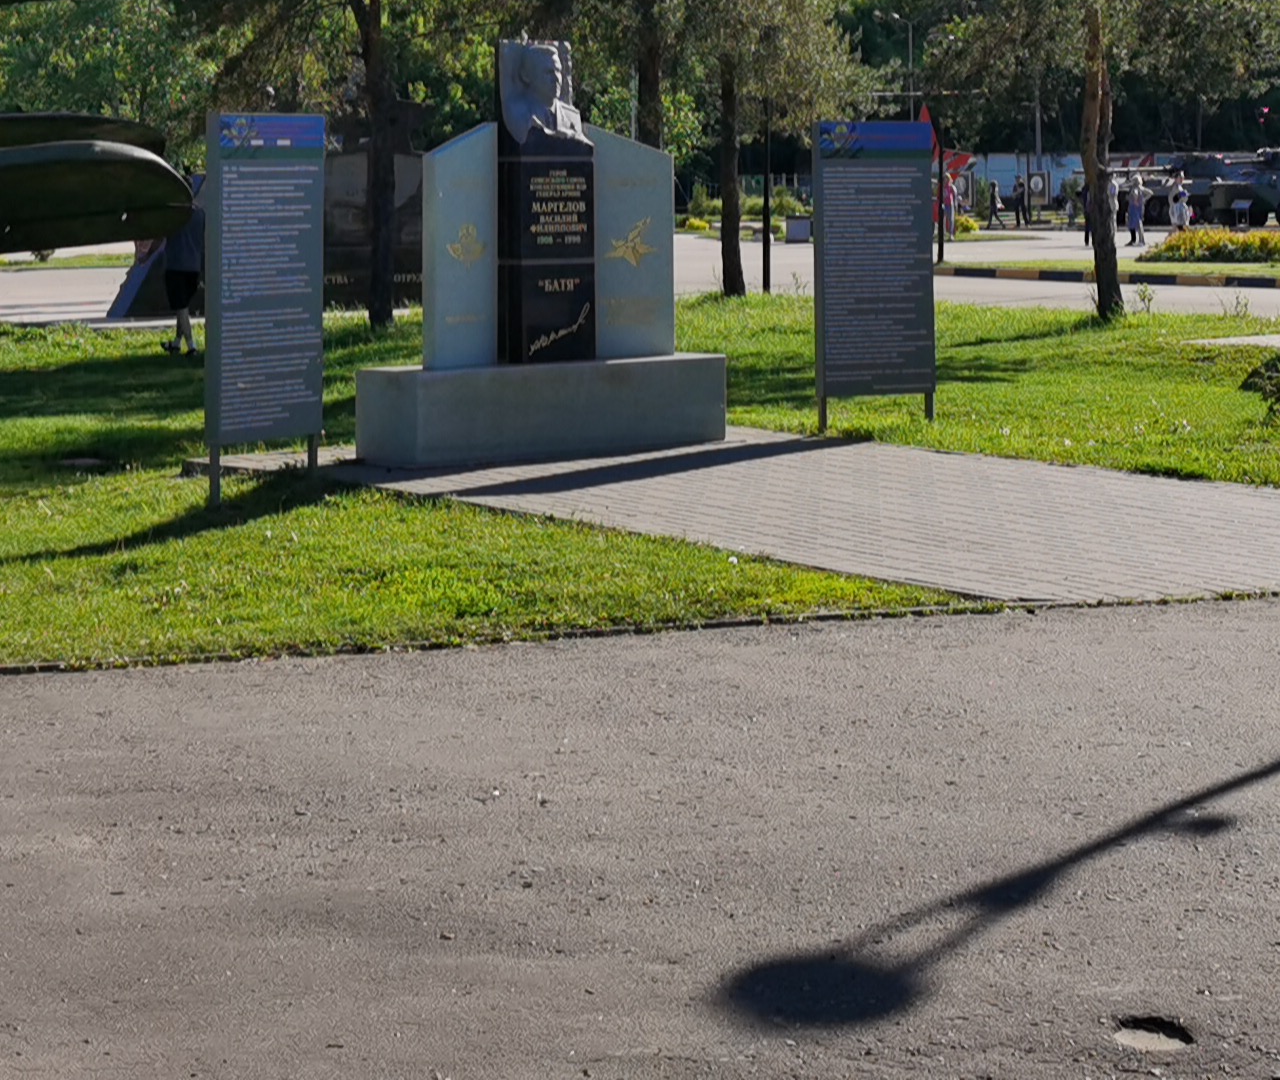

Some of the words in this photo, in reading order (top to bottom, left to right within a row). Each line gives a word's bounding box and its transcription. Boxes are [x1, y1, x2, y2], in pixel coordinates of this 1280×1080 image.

[531, 201, 587, 213] МАРГЕЛОВ
[539, 213, 579, 223] ВАСИЛИЙ
[529, 223, 588, 233] ФИЛИППОВИЧ
